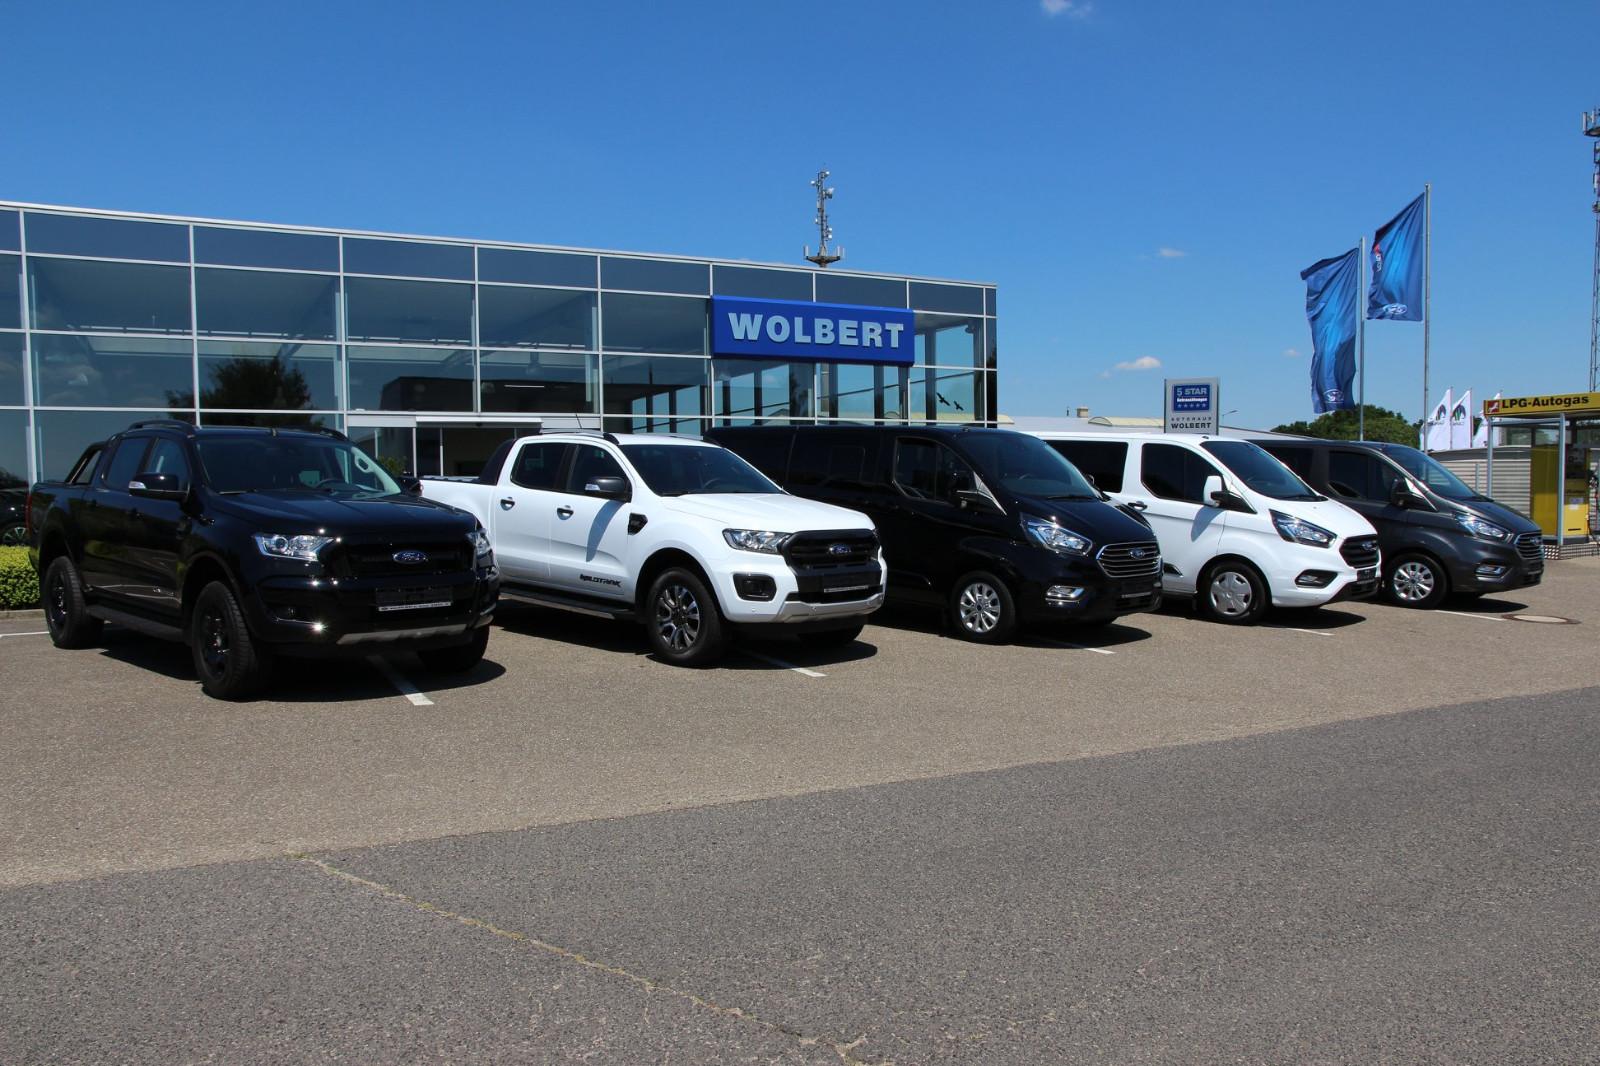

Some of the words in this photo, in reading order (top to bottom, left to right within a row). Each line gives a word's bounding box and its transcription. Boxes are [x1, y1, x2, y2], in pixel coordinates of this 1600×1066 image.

[728, 312, 904, 349] WOLBERT
[1177, 387, 1183, 396] 5
[1184, 387, 1207, 395] STAR
[1502, 395, 1589, 409] LPG-Autogas
